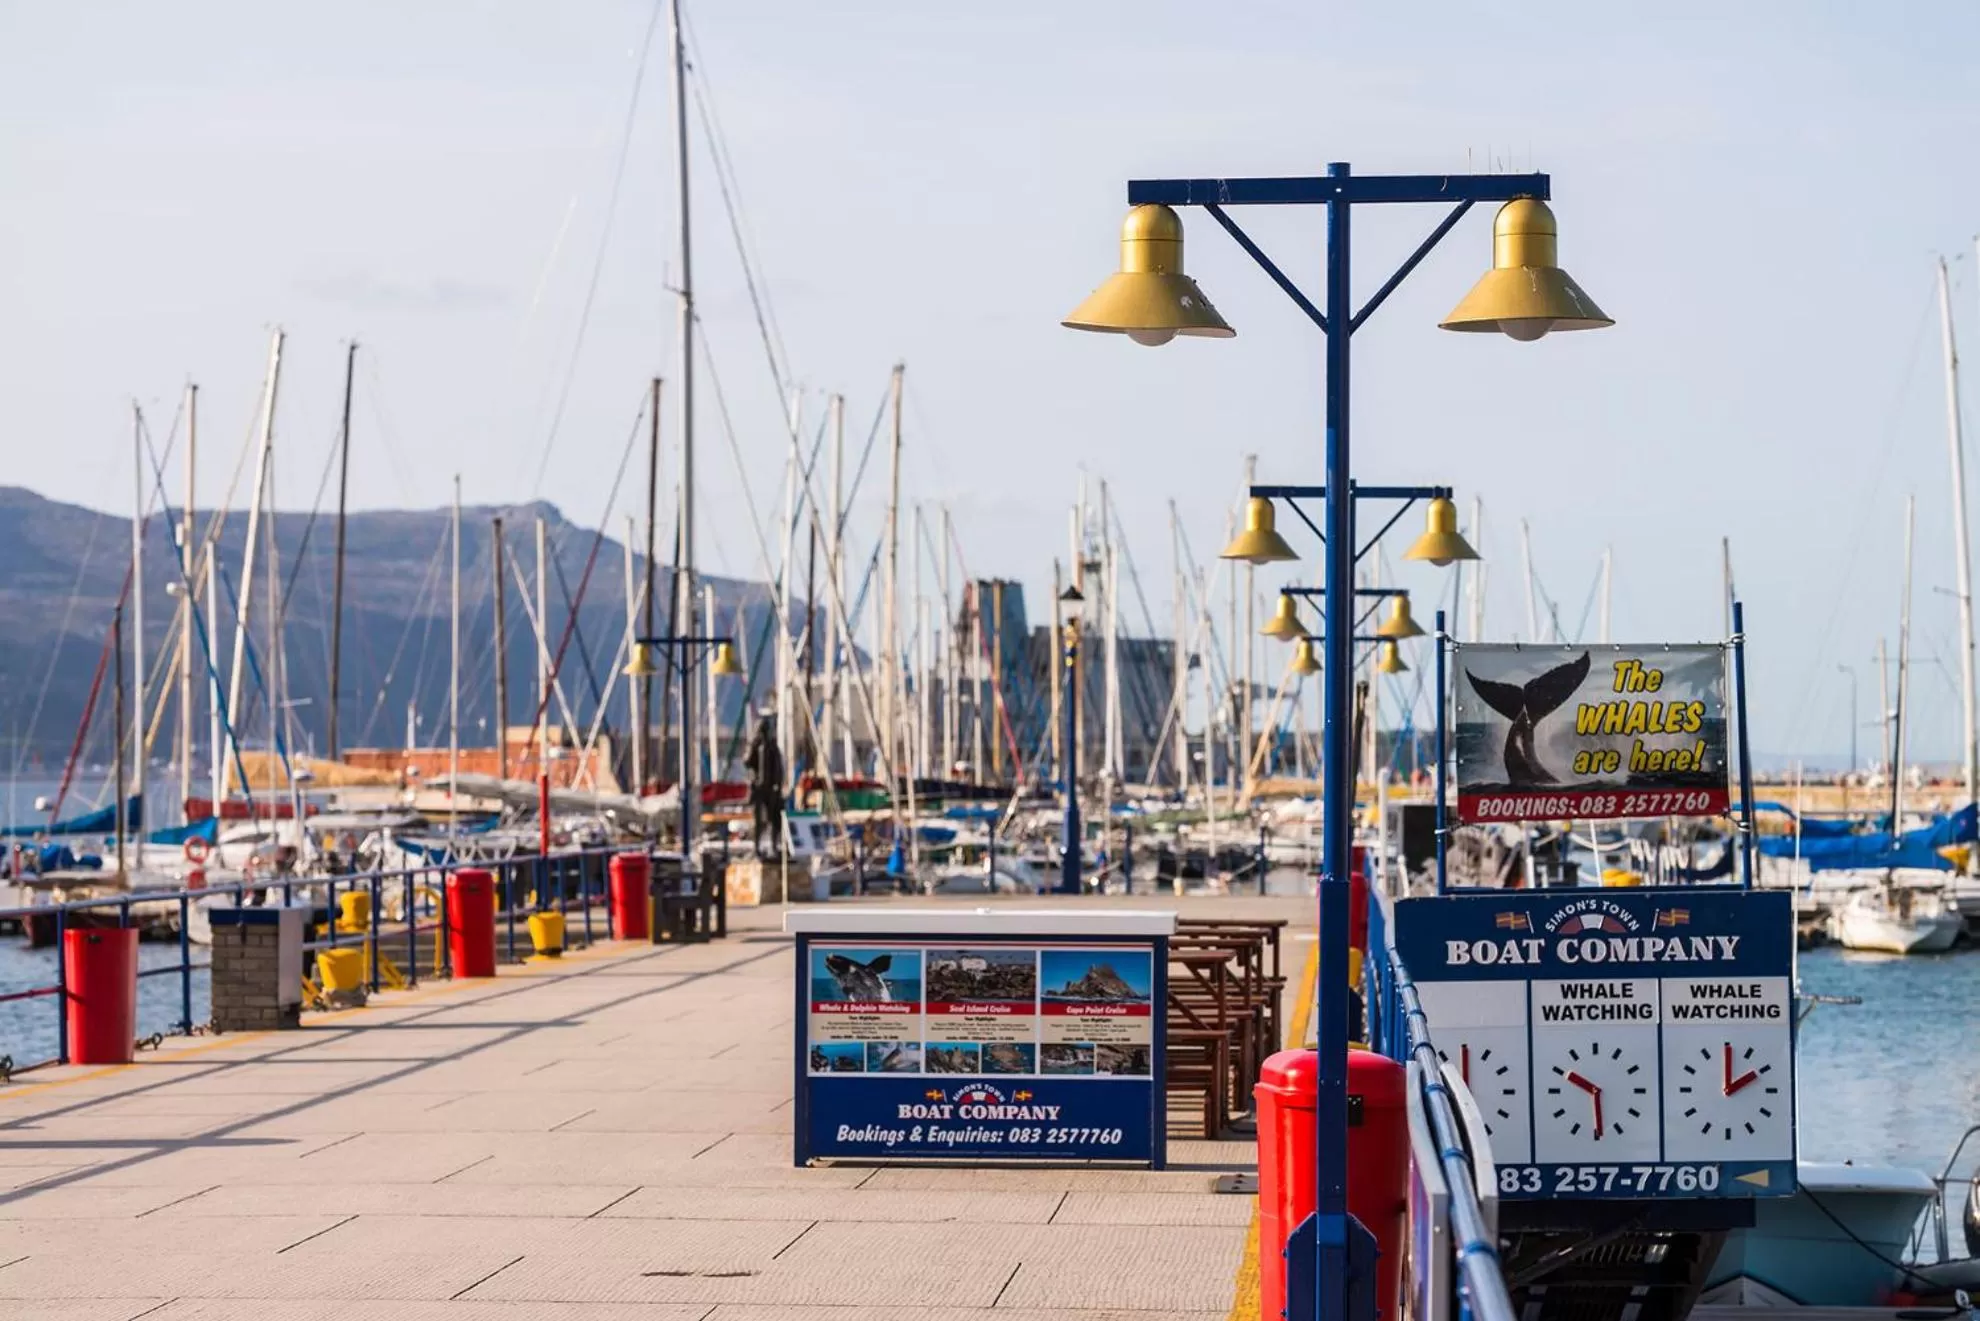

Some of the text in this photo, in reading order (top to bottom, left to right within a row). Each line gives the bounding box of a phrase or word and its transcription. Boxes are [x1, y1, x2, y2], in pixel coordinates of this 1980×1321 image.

[1613, 659, 1664, 693] The
[1576, 700, 1706, 736] WHALES
[1573, 739, 1706, 774] are here!
[1477, 792, 1710, 817] BOOKINGS: 083 2577760
[1545, 899, 1640, 933] SIMON'S TOWN
[1445, 935, 1740, 965] BOAT COMPANY
[1560, 983, 1634, 999] WHALE
[1690, 984, 1762, 998] WHALE
[819, 1003, 841, 1012] Whale
[878, 1003, 911, 1013] Watching
[949, 1004, 1012, 1013] Seal Island Cruise
[1085, 1005, 1104, 1014] Point
[1105, 1006, 1127, 1014] Cruise
[1542, 1003, 1653, 1021] WATCHING
[1672, 1004, 1780, 1019] WATCHING
[952, 1083, 1006, 1102] SIMON'S TOWN
[897, 1104, 1060, 1120] BOAT COMPANY
[836, 1124, 1123, 1147] Bookings & Enquiries: 083 2577760
[1554, 1166, 1719, 1192] 257-7760
